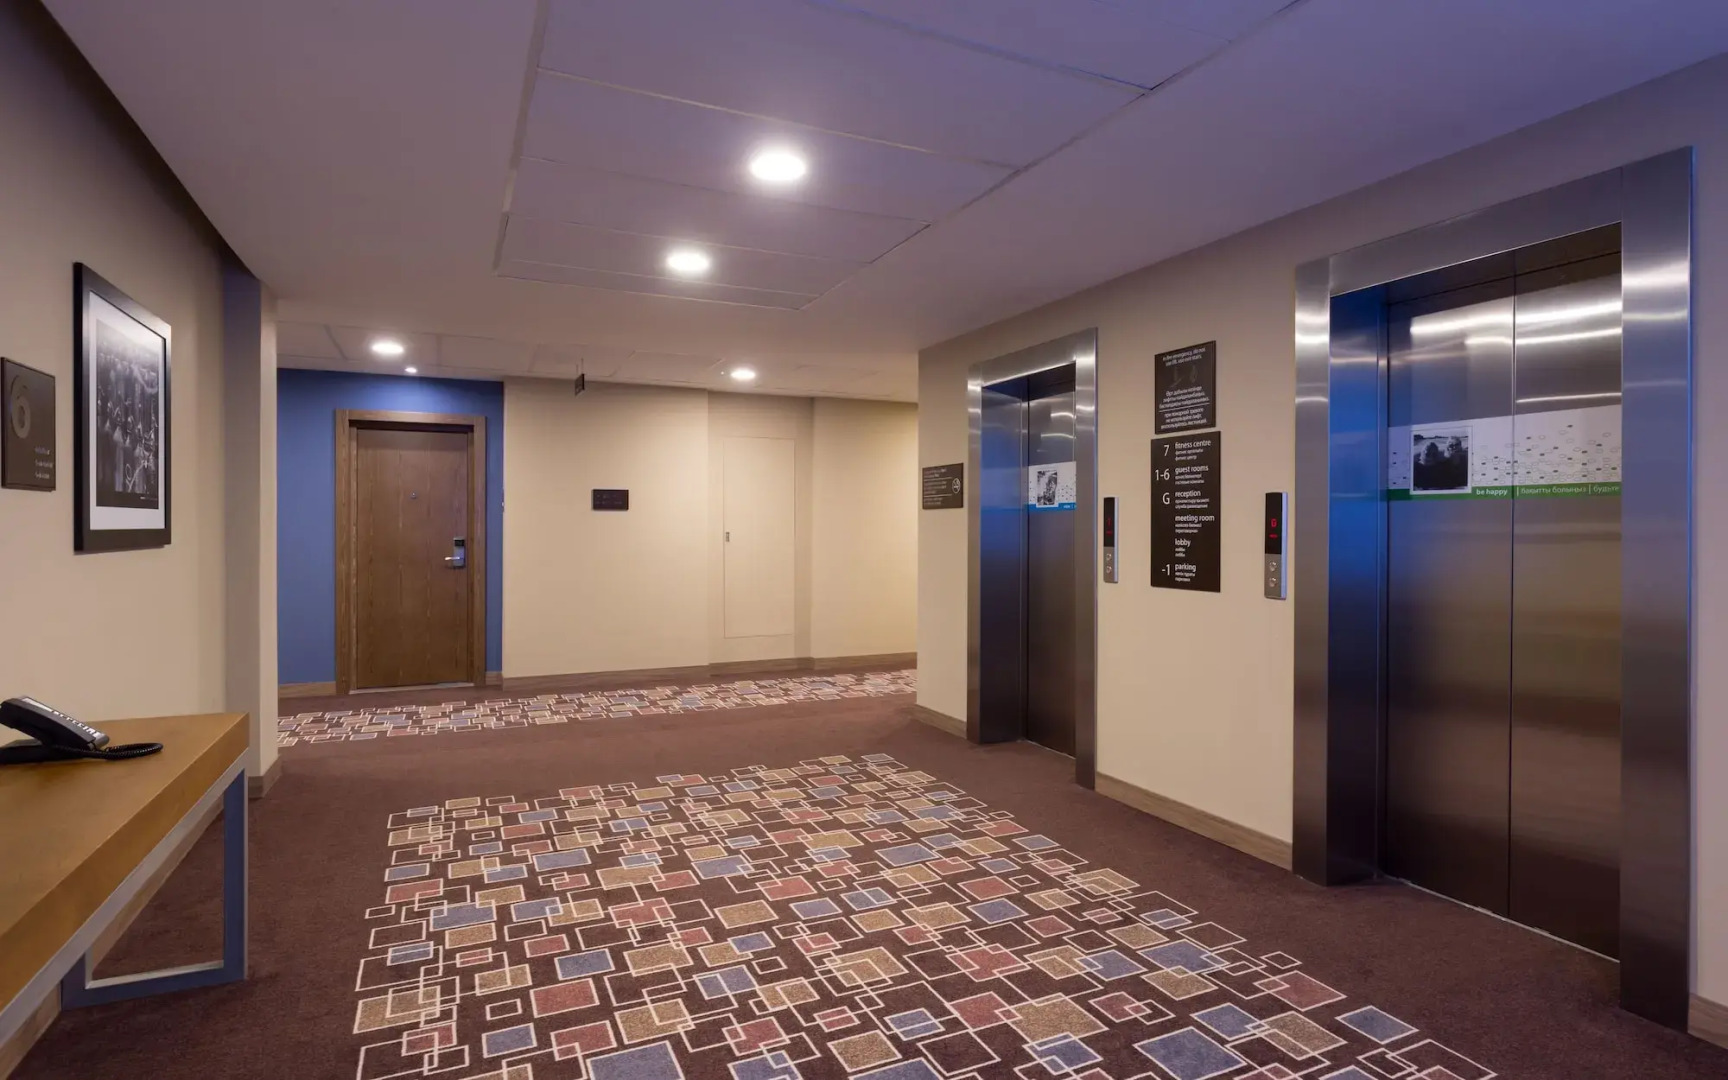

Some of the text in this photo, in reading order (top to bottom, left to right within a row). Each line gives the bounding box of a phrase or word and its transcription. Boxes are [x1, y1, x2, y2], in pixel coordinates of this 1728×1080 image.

[1164, 444, 1170, 457] 7
[1175, 442, 1193, 450] fitness
[1193, 440, 1212, 448] centre
[1155, 468, 1170, 481] 1-6
[1175, 466, 1190, 475] guest
[1162, 492, 1170, 505] G
[1175, 490, 1201, 498] reception
[1486, 488, 1508, 496] happy
[1175, 514, 1198, 523] meeting
[1175, 538, 1191, 547] lobby
[1162, 564, 1170, 576] -1
[1175, 563, 1197, 573] parking
